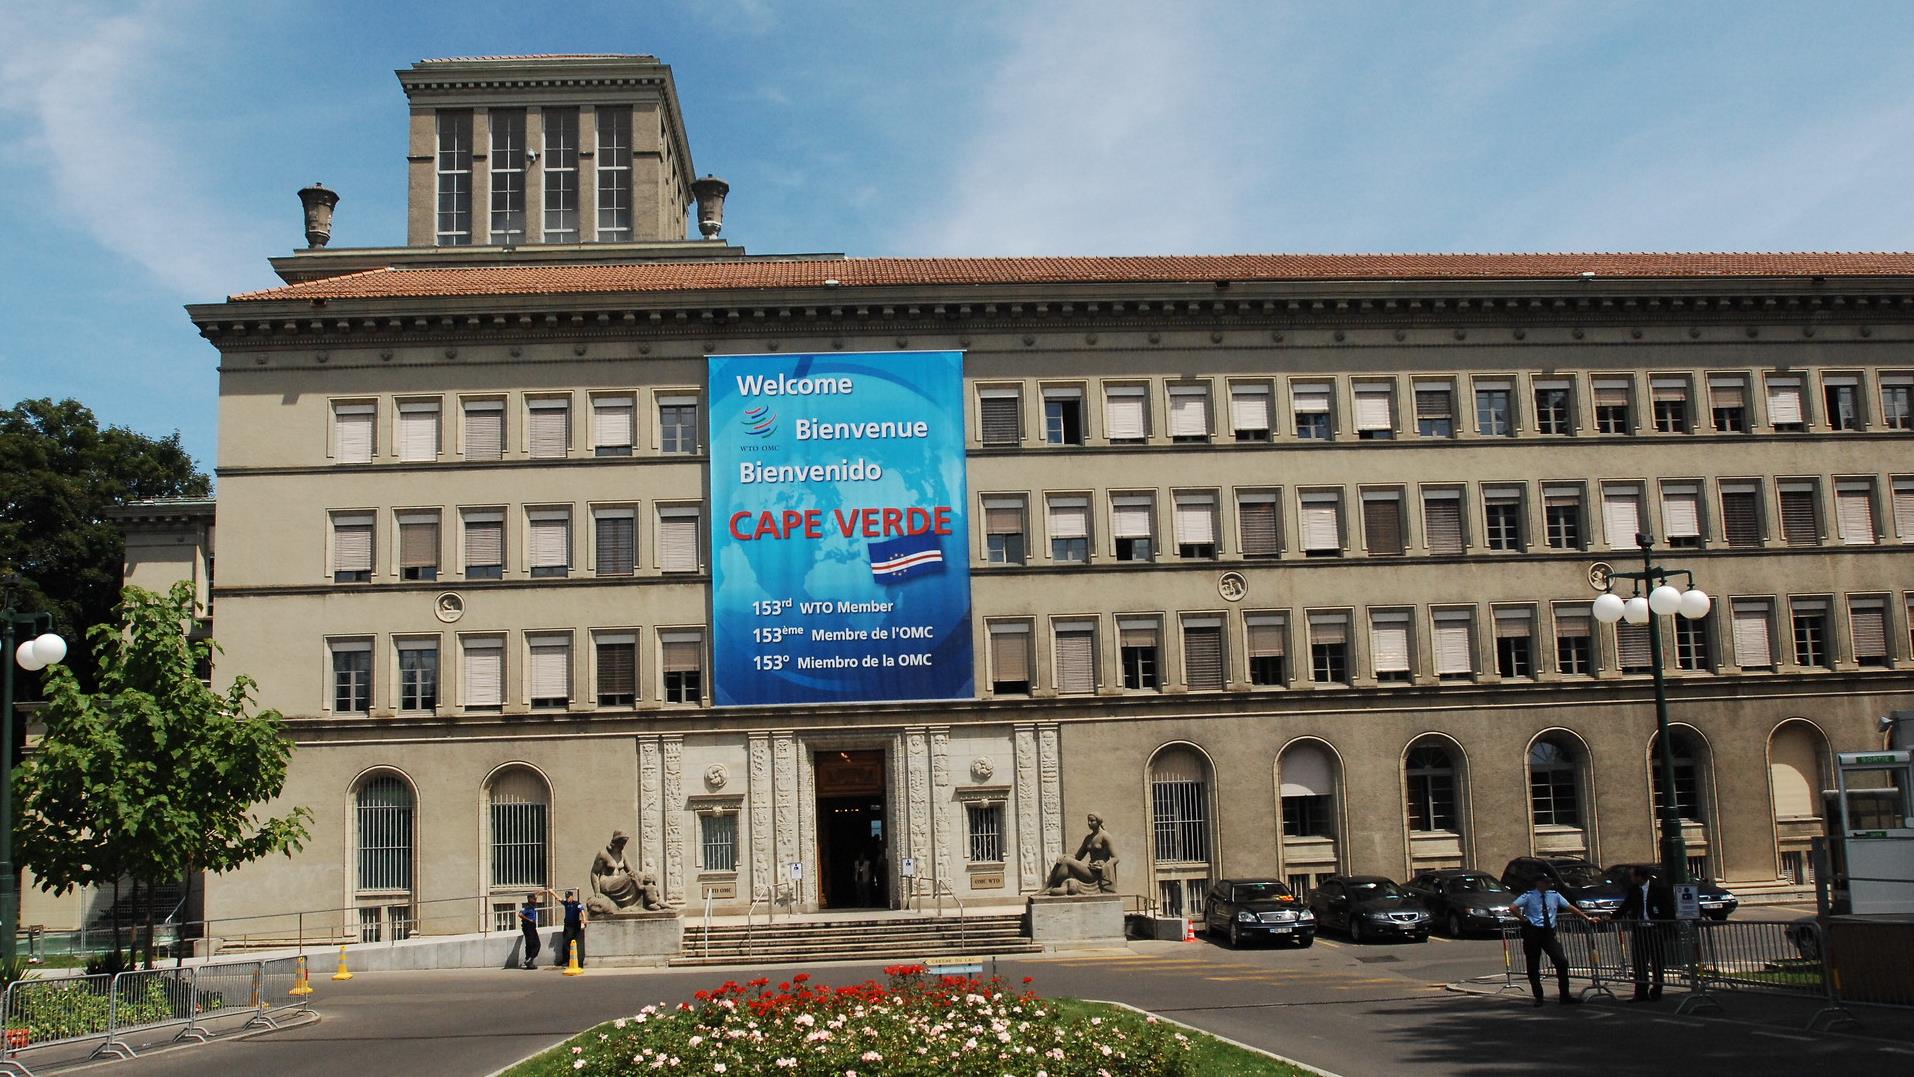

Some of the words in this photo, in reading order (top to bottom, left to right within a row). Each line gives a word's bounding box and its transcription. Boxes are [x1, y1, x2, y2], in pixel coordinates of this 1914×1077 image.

[736, 373, 853, 397] Welcome
[796, 418, 929, 441] Bienvenue
[739, 458, 883, 484] Bienvenido
[729, 509, 823, 540] CAPE
[834, 507, 953, 537] VERDE
[799, 602, 834, 614] WTO
[837, 600, 894, 613] Member
[811, 628, 868, 641] Membre
[871, 627, 888, 640] de
[892, 626, 934, 639] l'OMC
[797, 656, 859, 669] Miembro
[862, 655, 879, 667] de
[882, 654, 895, 667] la
[898, 653, 932, 666] OMC
